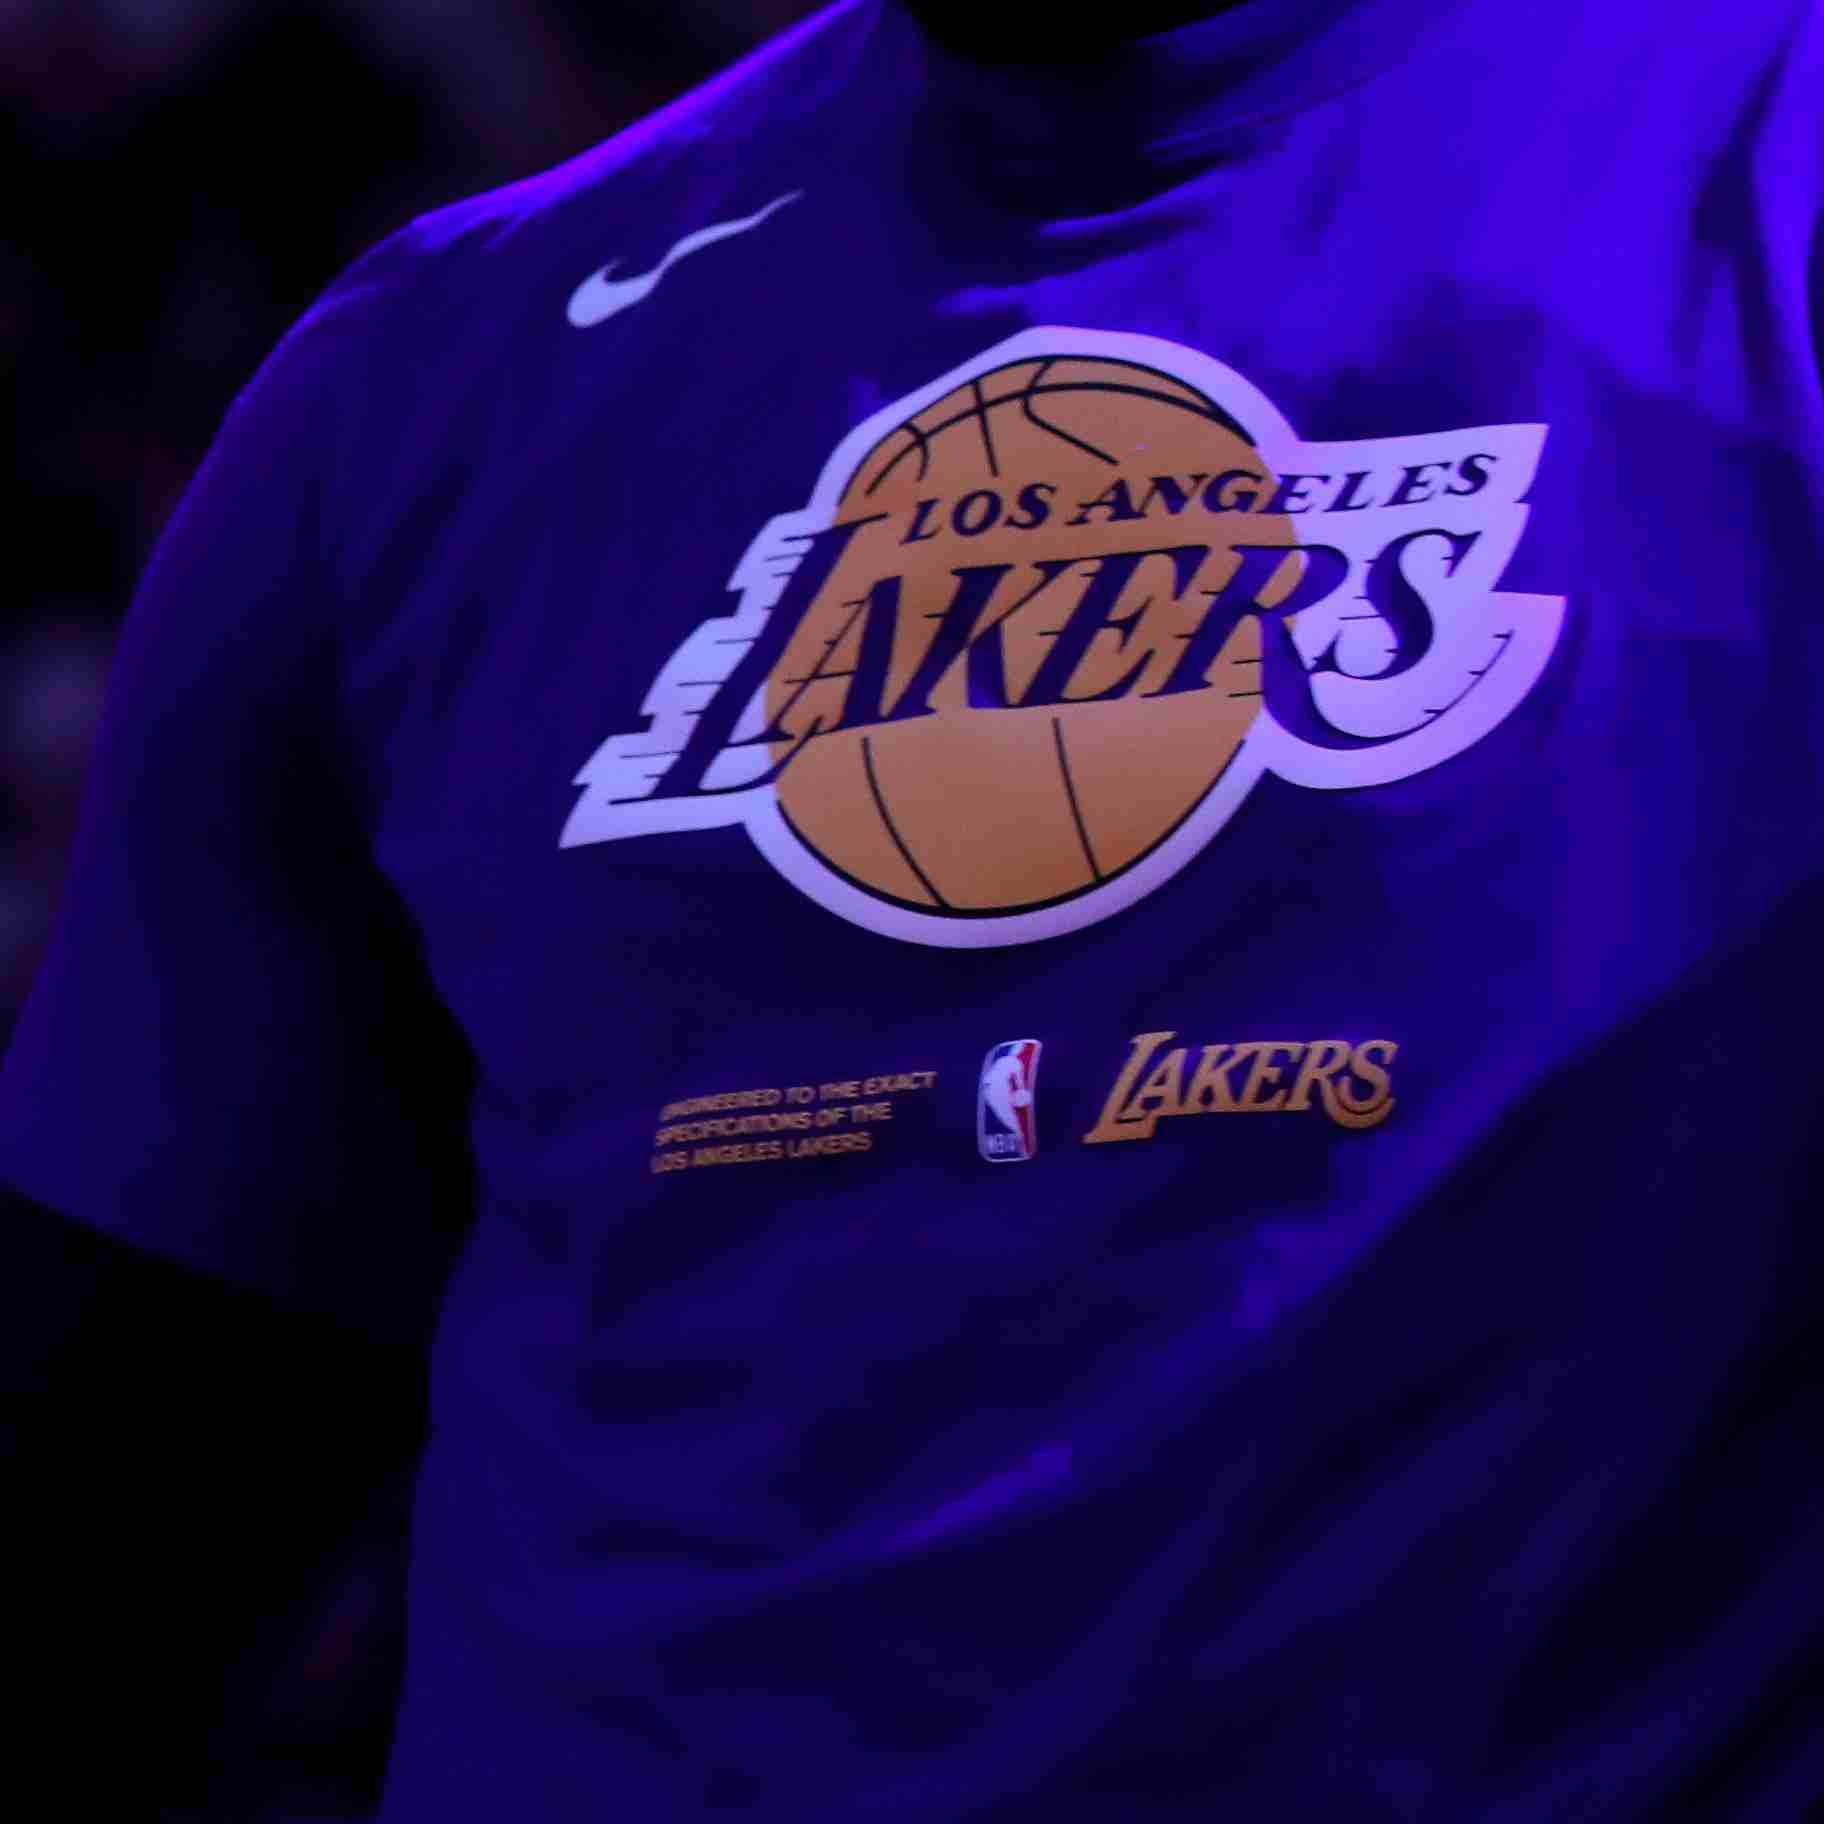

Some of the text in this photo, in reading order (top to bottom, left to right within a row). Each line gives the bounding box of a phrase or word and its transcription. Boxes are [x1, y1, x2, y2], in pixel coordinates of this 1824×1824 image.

[902, 453, 1496, 545] LOS ANGELES
[608, 511, 1512, 805] LAKERS
[654, 1101, 895, 1147] SPECIFICATIONS OF THE
[659, 1071, 938, 1123] ENGINEERED TO THE EXACT
[1081, 1031, 1398, 1145] LAKERS
[649, 1130, 873, 1175] LOS ANGELES LAKERS
